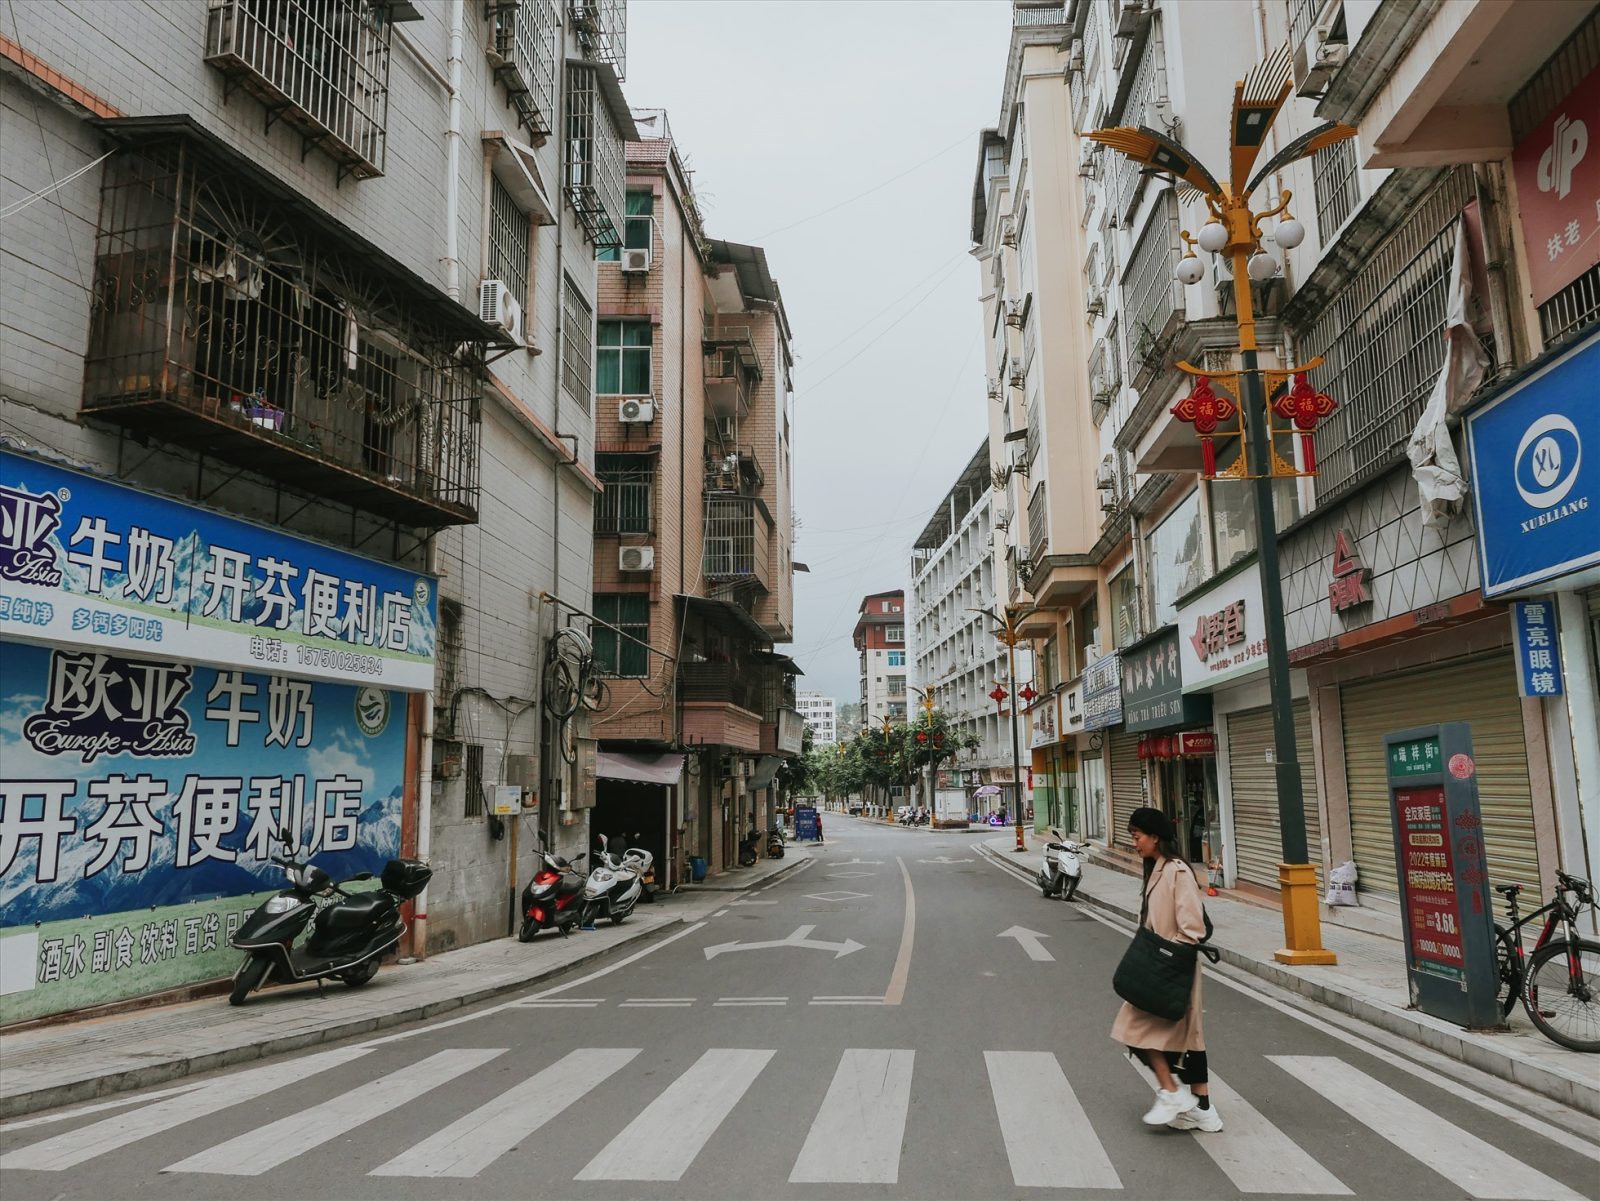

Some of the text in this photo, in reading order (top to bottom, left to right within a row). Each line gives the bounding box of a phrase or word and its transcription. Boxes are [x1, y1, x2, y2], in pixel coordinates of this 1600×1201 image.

[1547, 219, 1581, 262] 扶老
[1199, 402, 1214, 416] 福
[1299, 398, 1314, 412] 福
[1520, 497, 1588, 533] XUELIANG
[67, 515, 176, 604] 牛奶
[203, 542, 412, 653] 开芬便利店
[72, 607, 163, 642] 多钙多阳光
[296, 645, 383, 676] 15750025934
[1524, 604, 1556, 693] 雪亮眼镜
[52, 651, 192, 724] 欧亚
[205, 669, 314, 748] 牛奶
[27, 717, 196, 759] Europe-Asia
[1398, 742, 1434, 762] 瑞祥街
[0, 774, 363, 883] 开芬便利店
[1404, 805, 1431, 821] 全友家居
[1434, 911, 1454, 935] 3.68
[38, 934, 86, 984] 酒水
[92, 927, 135, 974] 副食
[140, 916, 177, 965] 饮料
[184, 912, 220, 955] 百货
